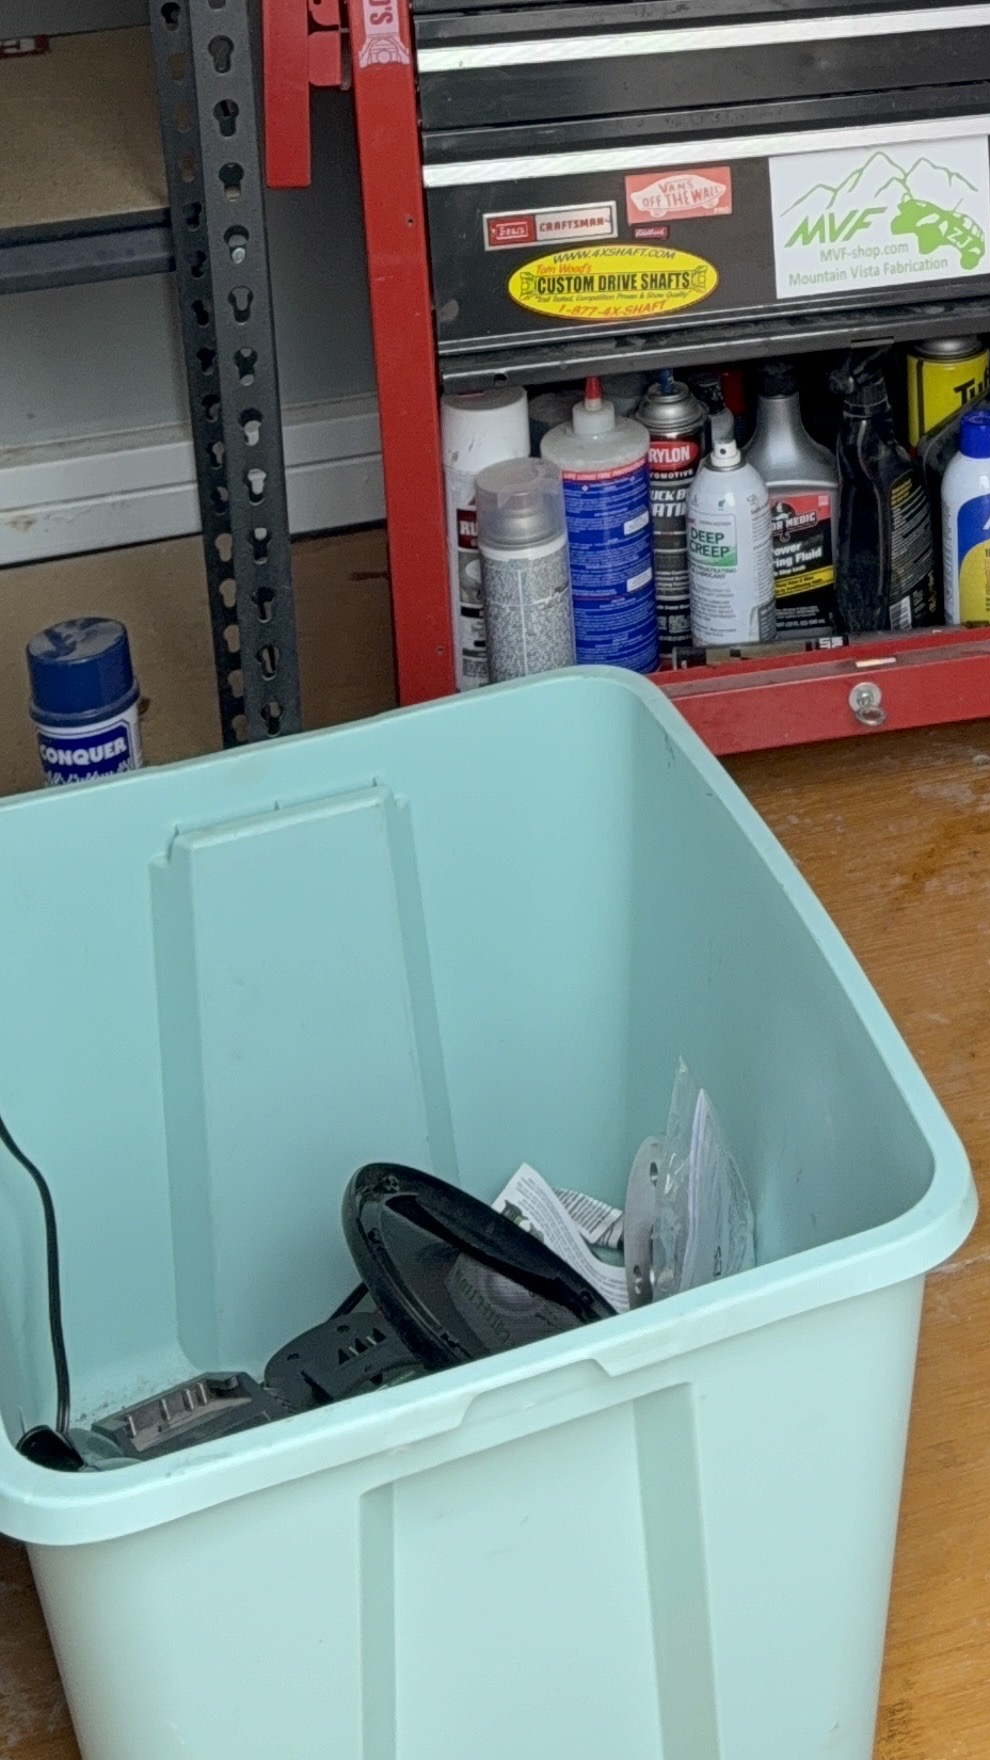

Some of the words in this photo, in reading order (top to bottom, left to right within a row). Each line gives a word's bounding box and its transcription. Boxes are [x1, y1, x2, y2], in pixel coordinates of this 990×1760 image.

[658, 178, 695, 194] VANS
[642, 195, 661, 207] OFF
[665, 191, 690, 207] THE
[690, 186, 718, 202] WALL
[539, 217, 605, 232] CRAFTSMAN
[784, 206, 888, 248] MVF
[820, 243, 909, 262] MVF-shop.com
[536, 264, 556, 274] Tom
[789, 269, 847, 287] Mountain
[850, 264, 880, 281] Vista
[883, 257, 948, 276] Fabrication
[537, 274, 594, 294] CUSTOM
[598, 273, 637, 291] DRIVE
[641, 272, 690, 290] SHAFTS
[648, 444, 691, 463] RYLON
[650, 489, 674, 501] UCK
[690, 526, 725, 544] DEEP
[689, 540, 730, 558] CREEP
[773, 542, 802, 556] ower
[795, 546, 823, 563] Fluid
[40, 736, 127, 766] CONQUER
